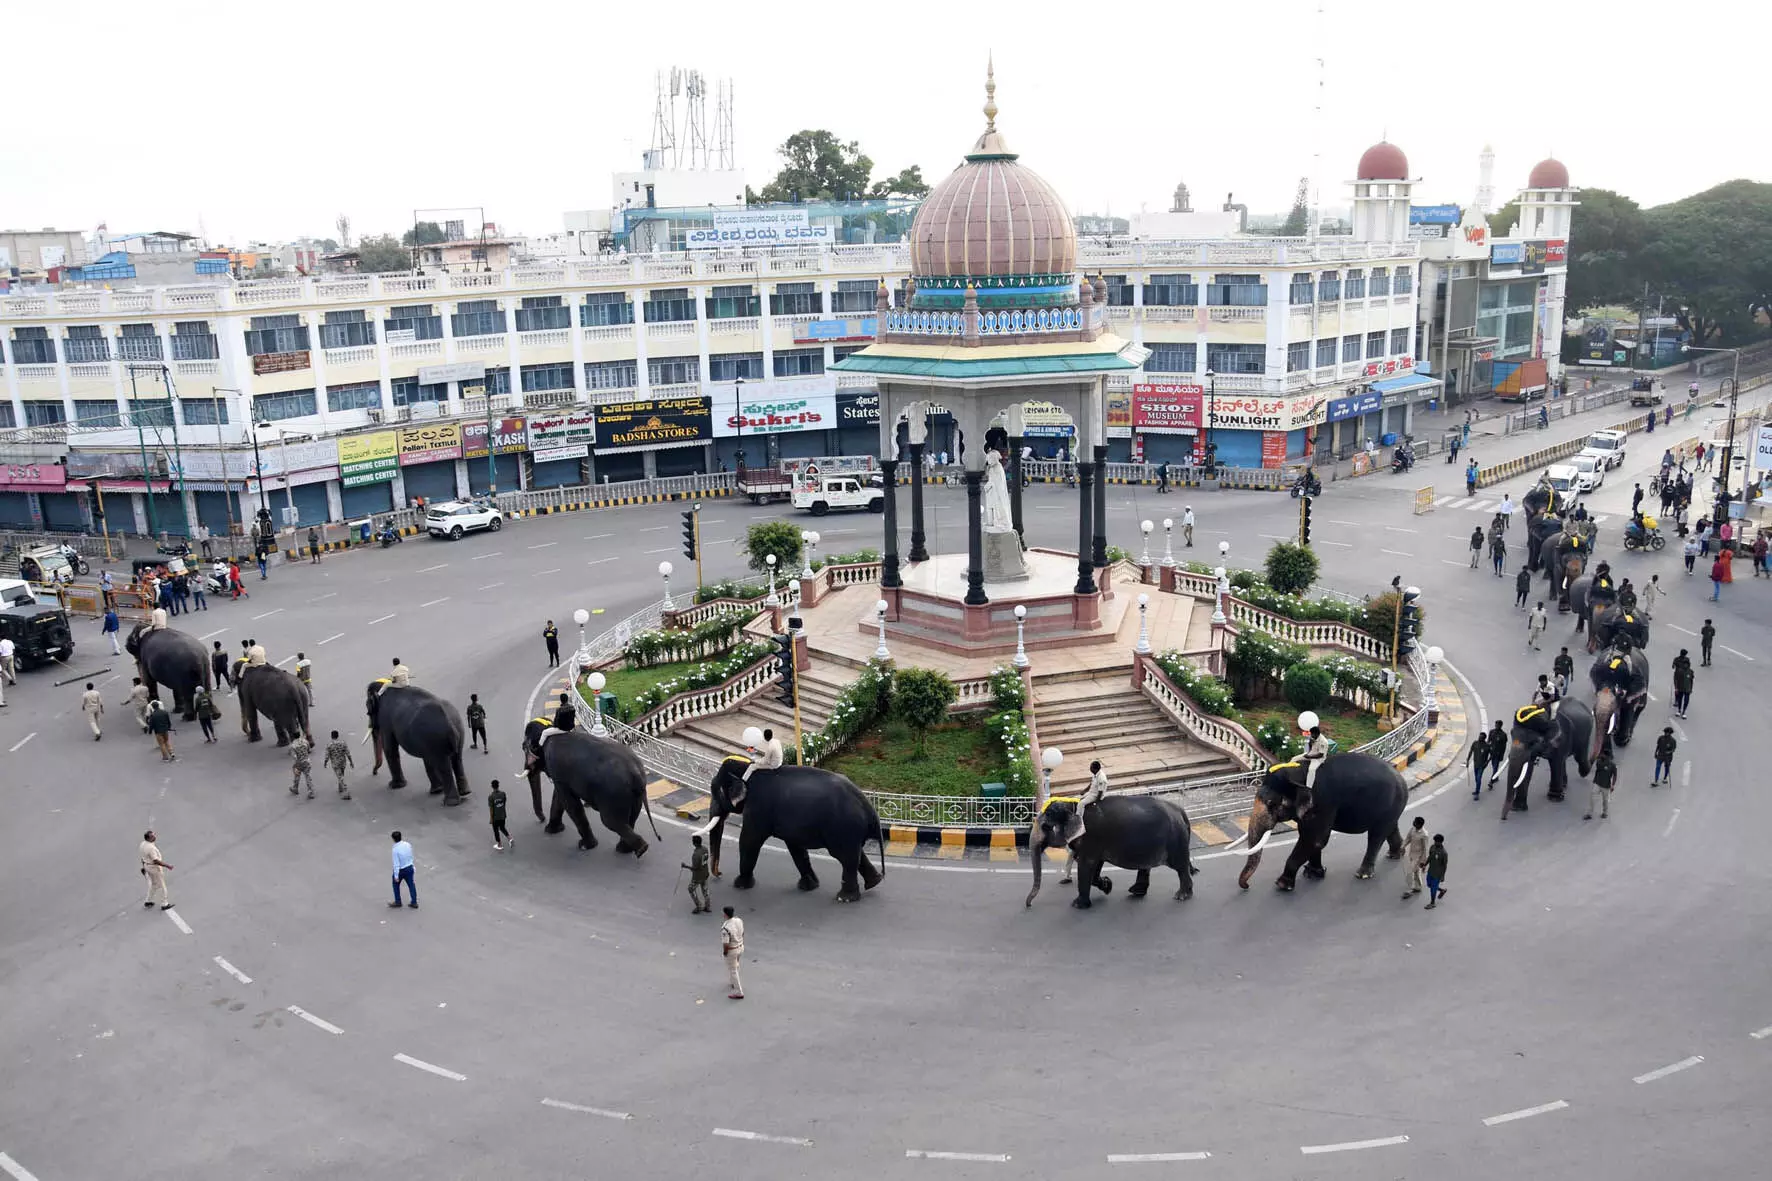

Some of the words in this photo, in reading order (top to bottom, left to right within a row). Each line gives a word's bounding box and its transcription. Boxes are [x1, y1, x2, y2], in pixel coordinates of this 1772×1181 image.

[785, 225, 827, 240] ಭವನ
[843, 407, 880, 418] States
[1140, 404, 1195, 412] SHOE
[727, 412, 822, 428] Sukri's
[1211, 415, 1281, 425] SUNLIGHT
[403, 428, 455, 442] ಪಲ್ಲವಿ
[612, 432, 656, 443] BADSHA
[658, 427, 699, 438] STORES
[430, 440, 457, 448] TEXTILES
[503, 444, 526, 452] CENTRE
[342, 462, 373, 473] MATCHING
[374, 458, 396, 468] CENTRE
[343, 474, 374, 485] MATCHING
[375, 470, 397, 480] CENTER
